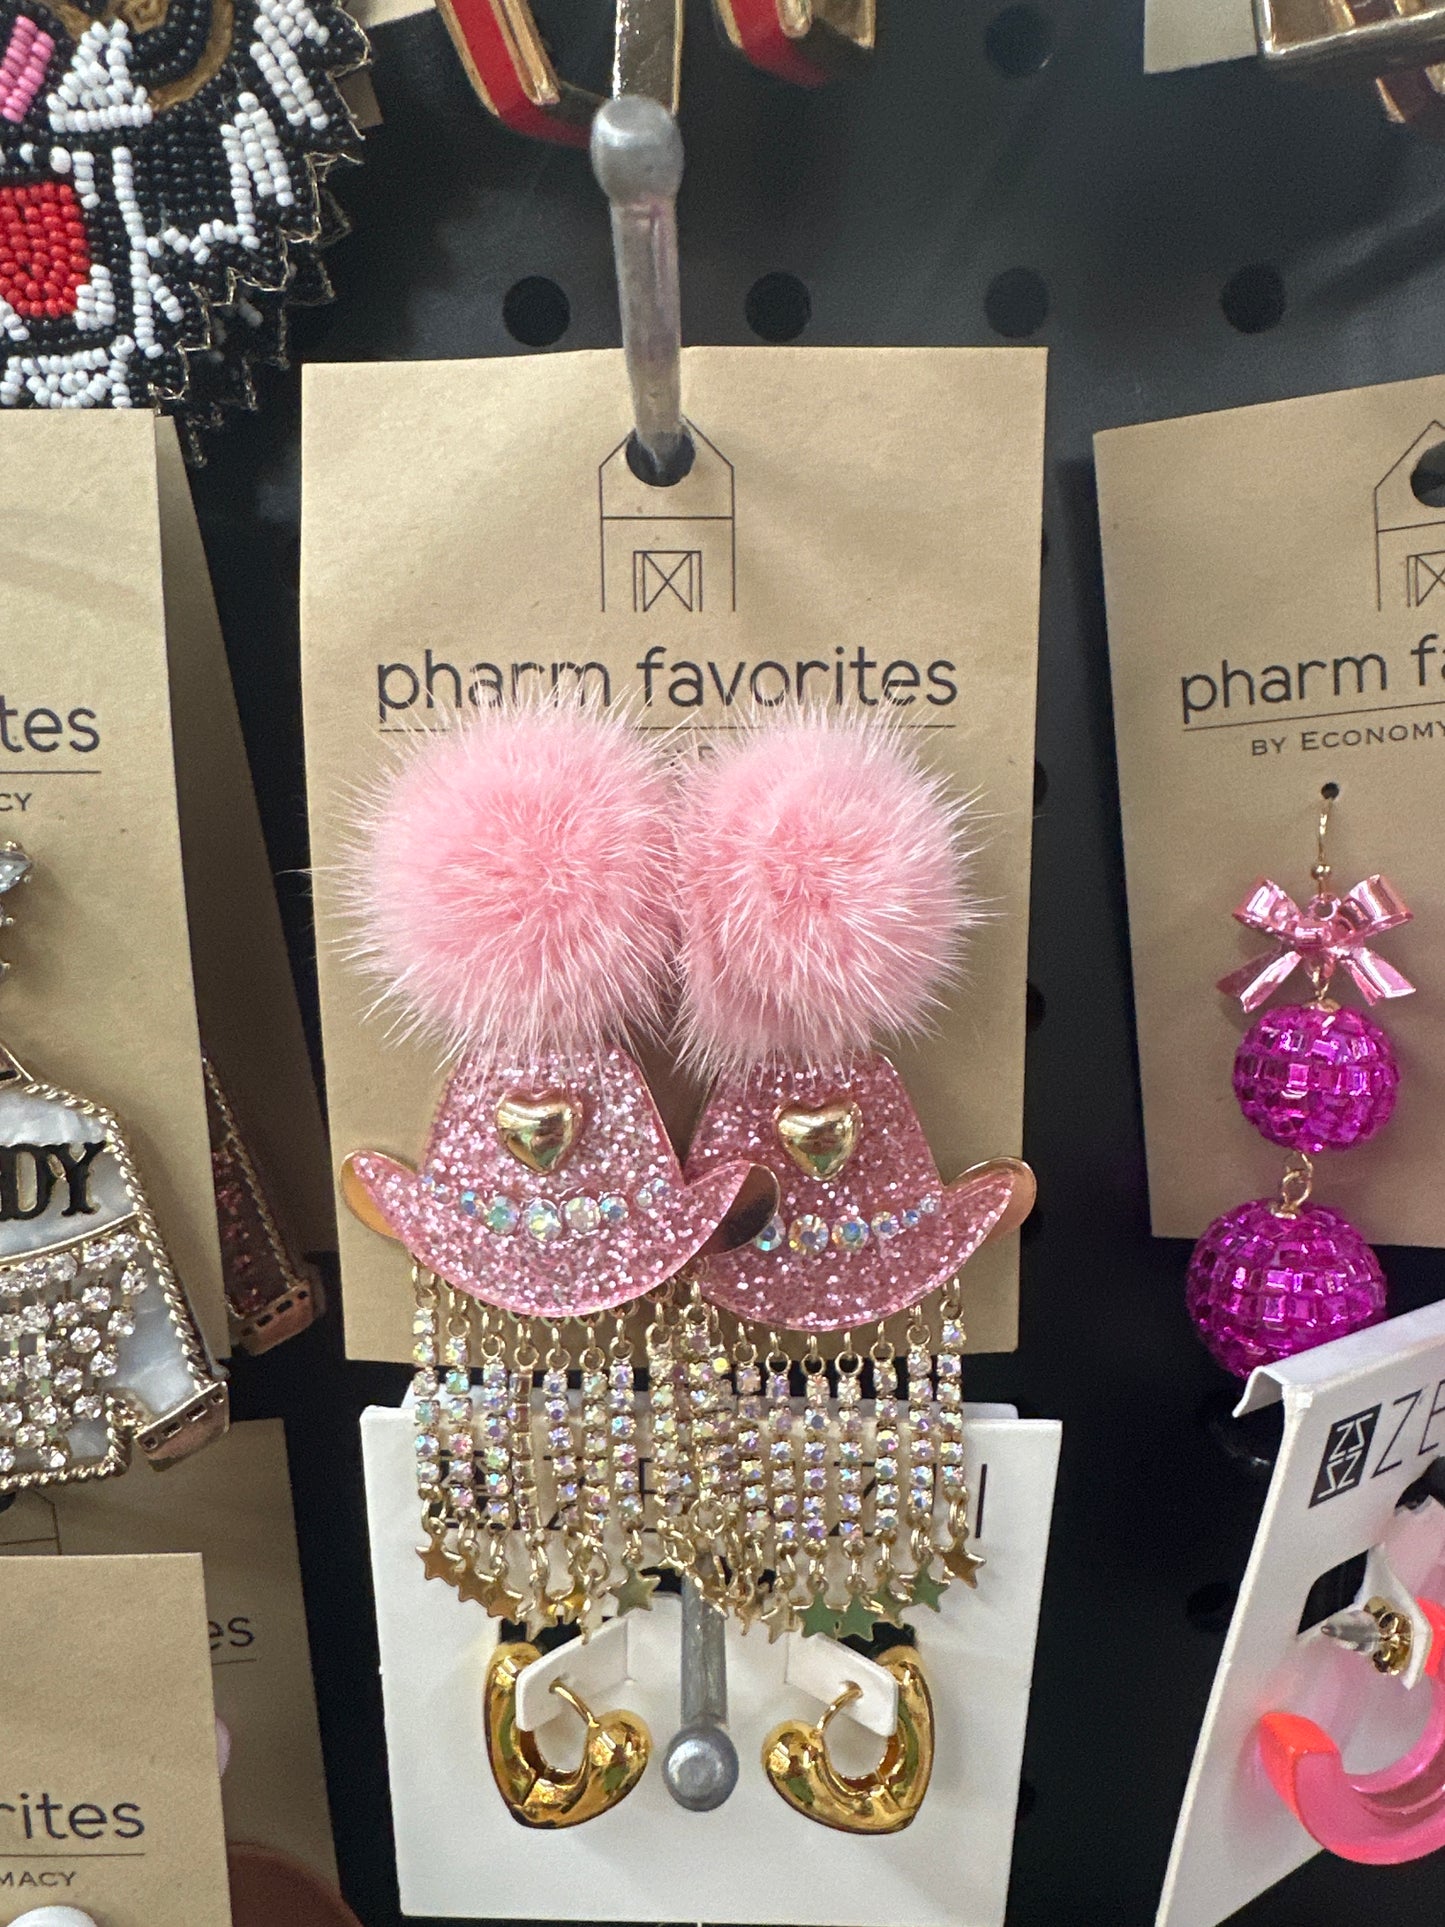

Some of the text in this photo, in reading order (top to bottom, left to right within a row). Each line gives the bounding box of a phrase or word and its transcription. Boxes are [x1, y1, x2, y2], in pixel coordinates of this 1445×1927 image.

[377, 645, 958, 723] pharm favorites
[1181, 633, 1445, 724] pharm f
[1251, 736, 1286, 756] BY
